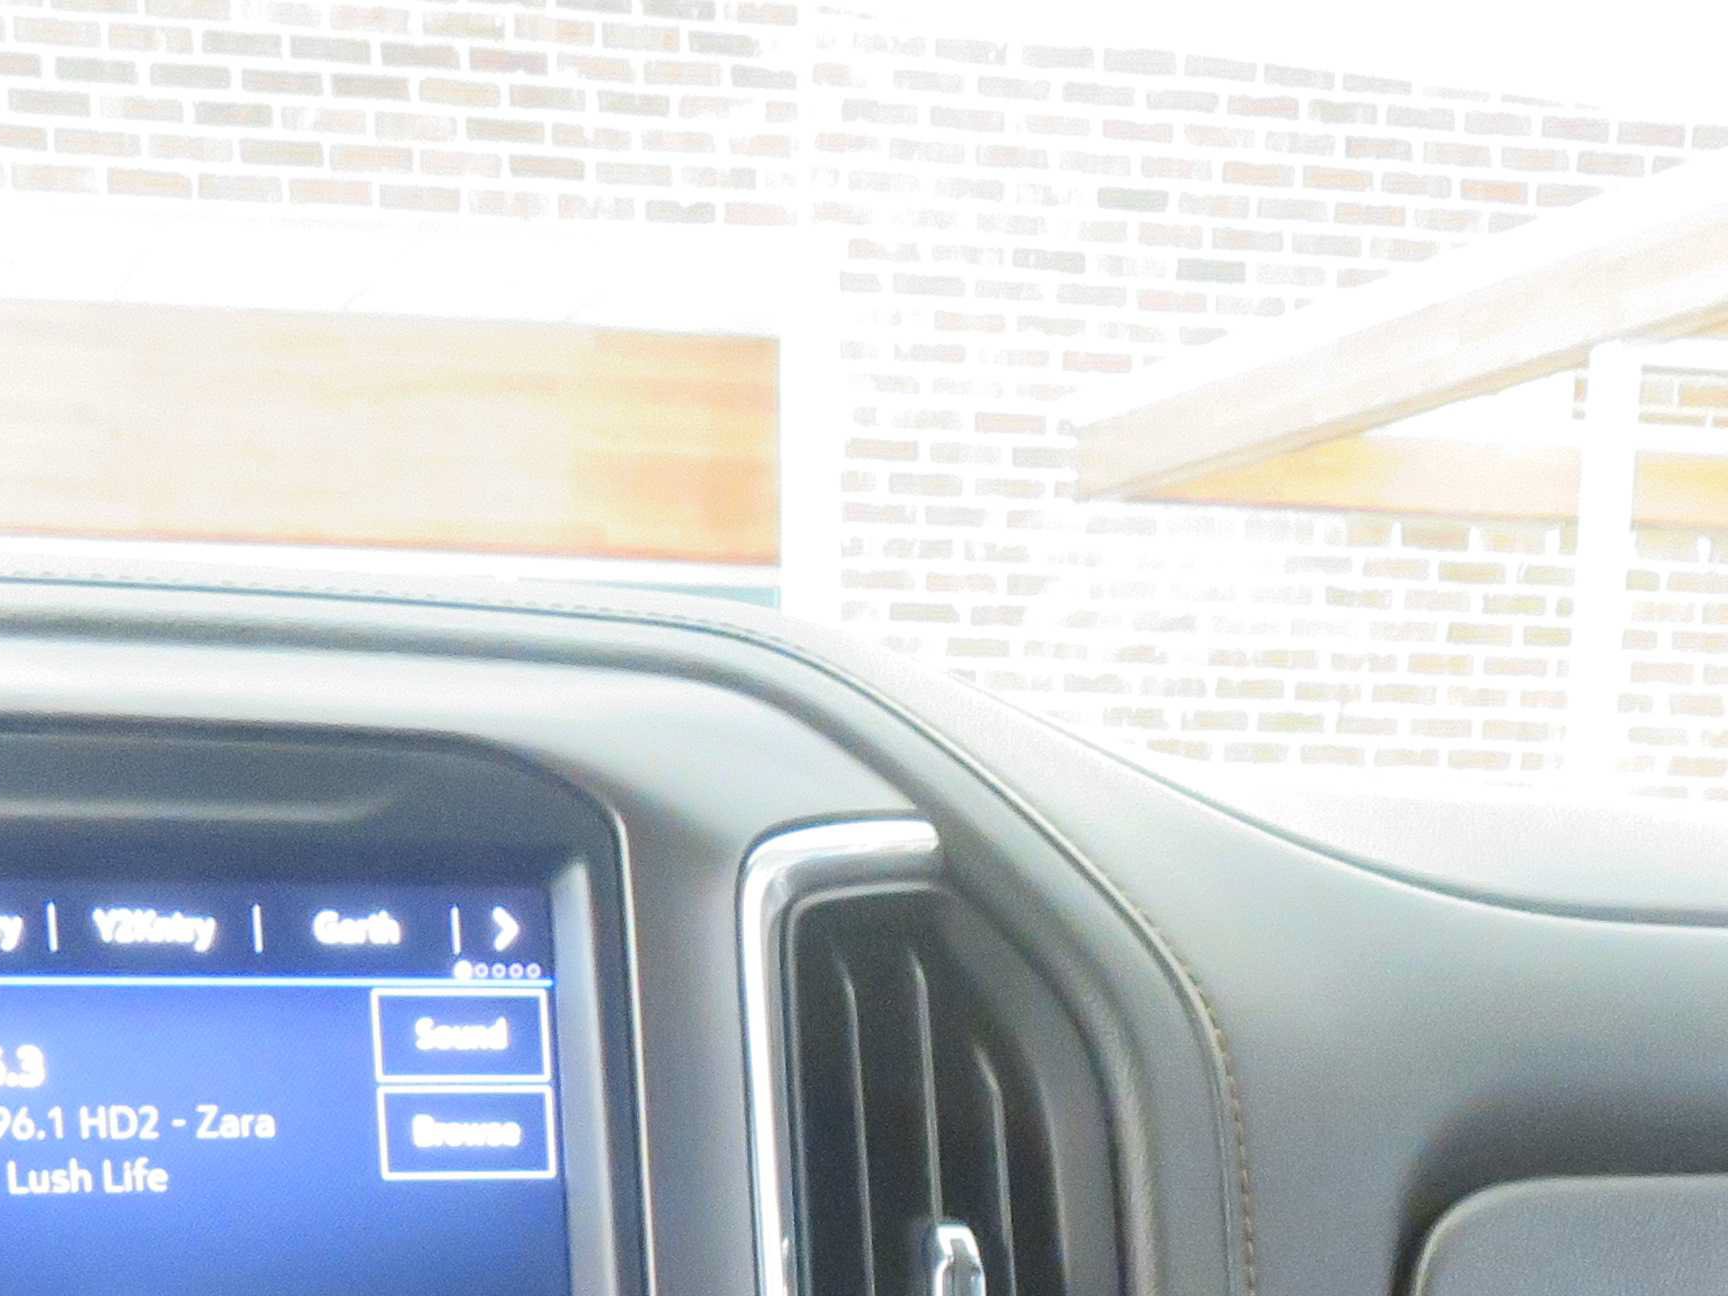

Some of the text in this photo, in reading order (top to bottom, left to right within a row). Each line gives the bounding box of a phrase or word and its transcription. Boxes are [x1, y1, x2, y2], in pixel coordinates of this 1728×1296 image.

[414, 1017, 511, 1052] Sound
[78, 1104, 160, 1140] HD2
[196, 1103, 277, 1140] Zara
[6, 1158, 94, 1195] Lush
[102, 1156, 169, 1194] Life
